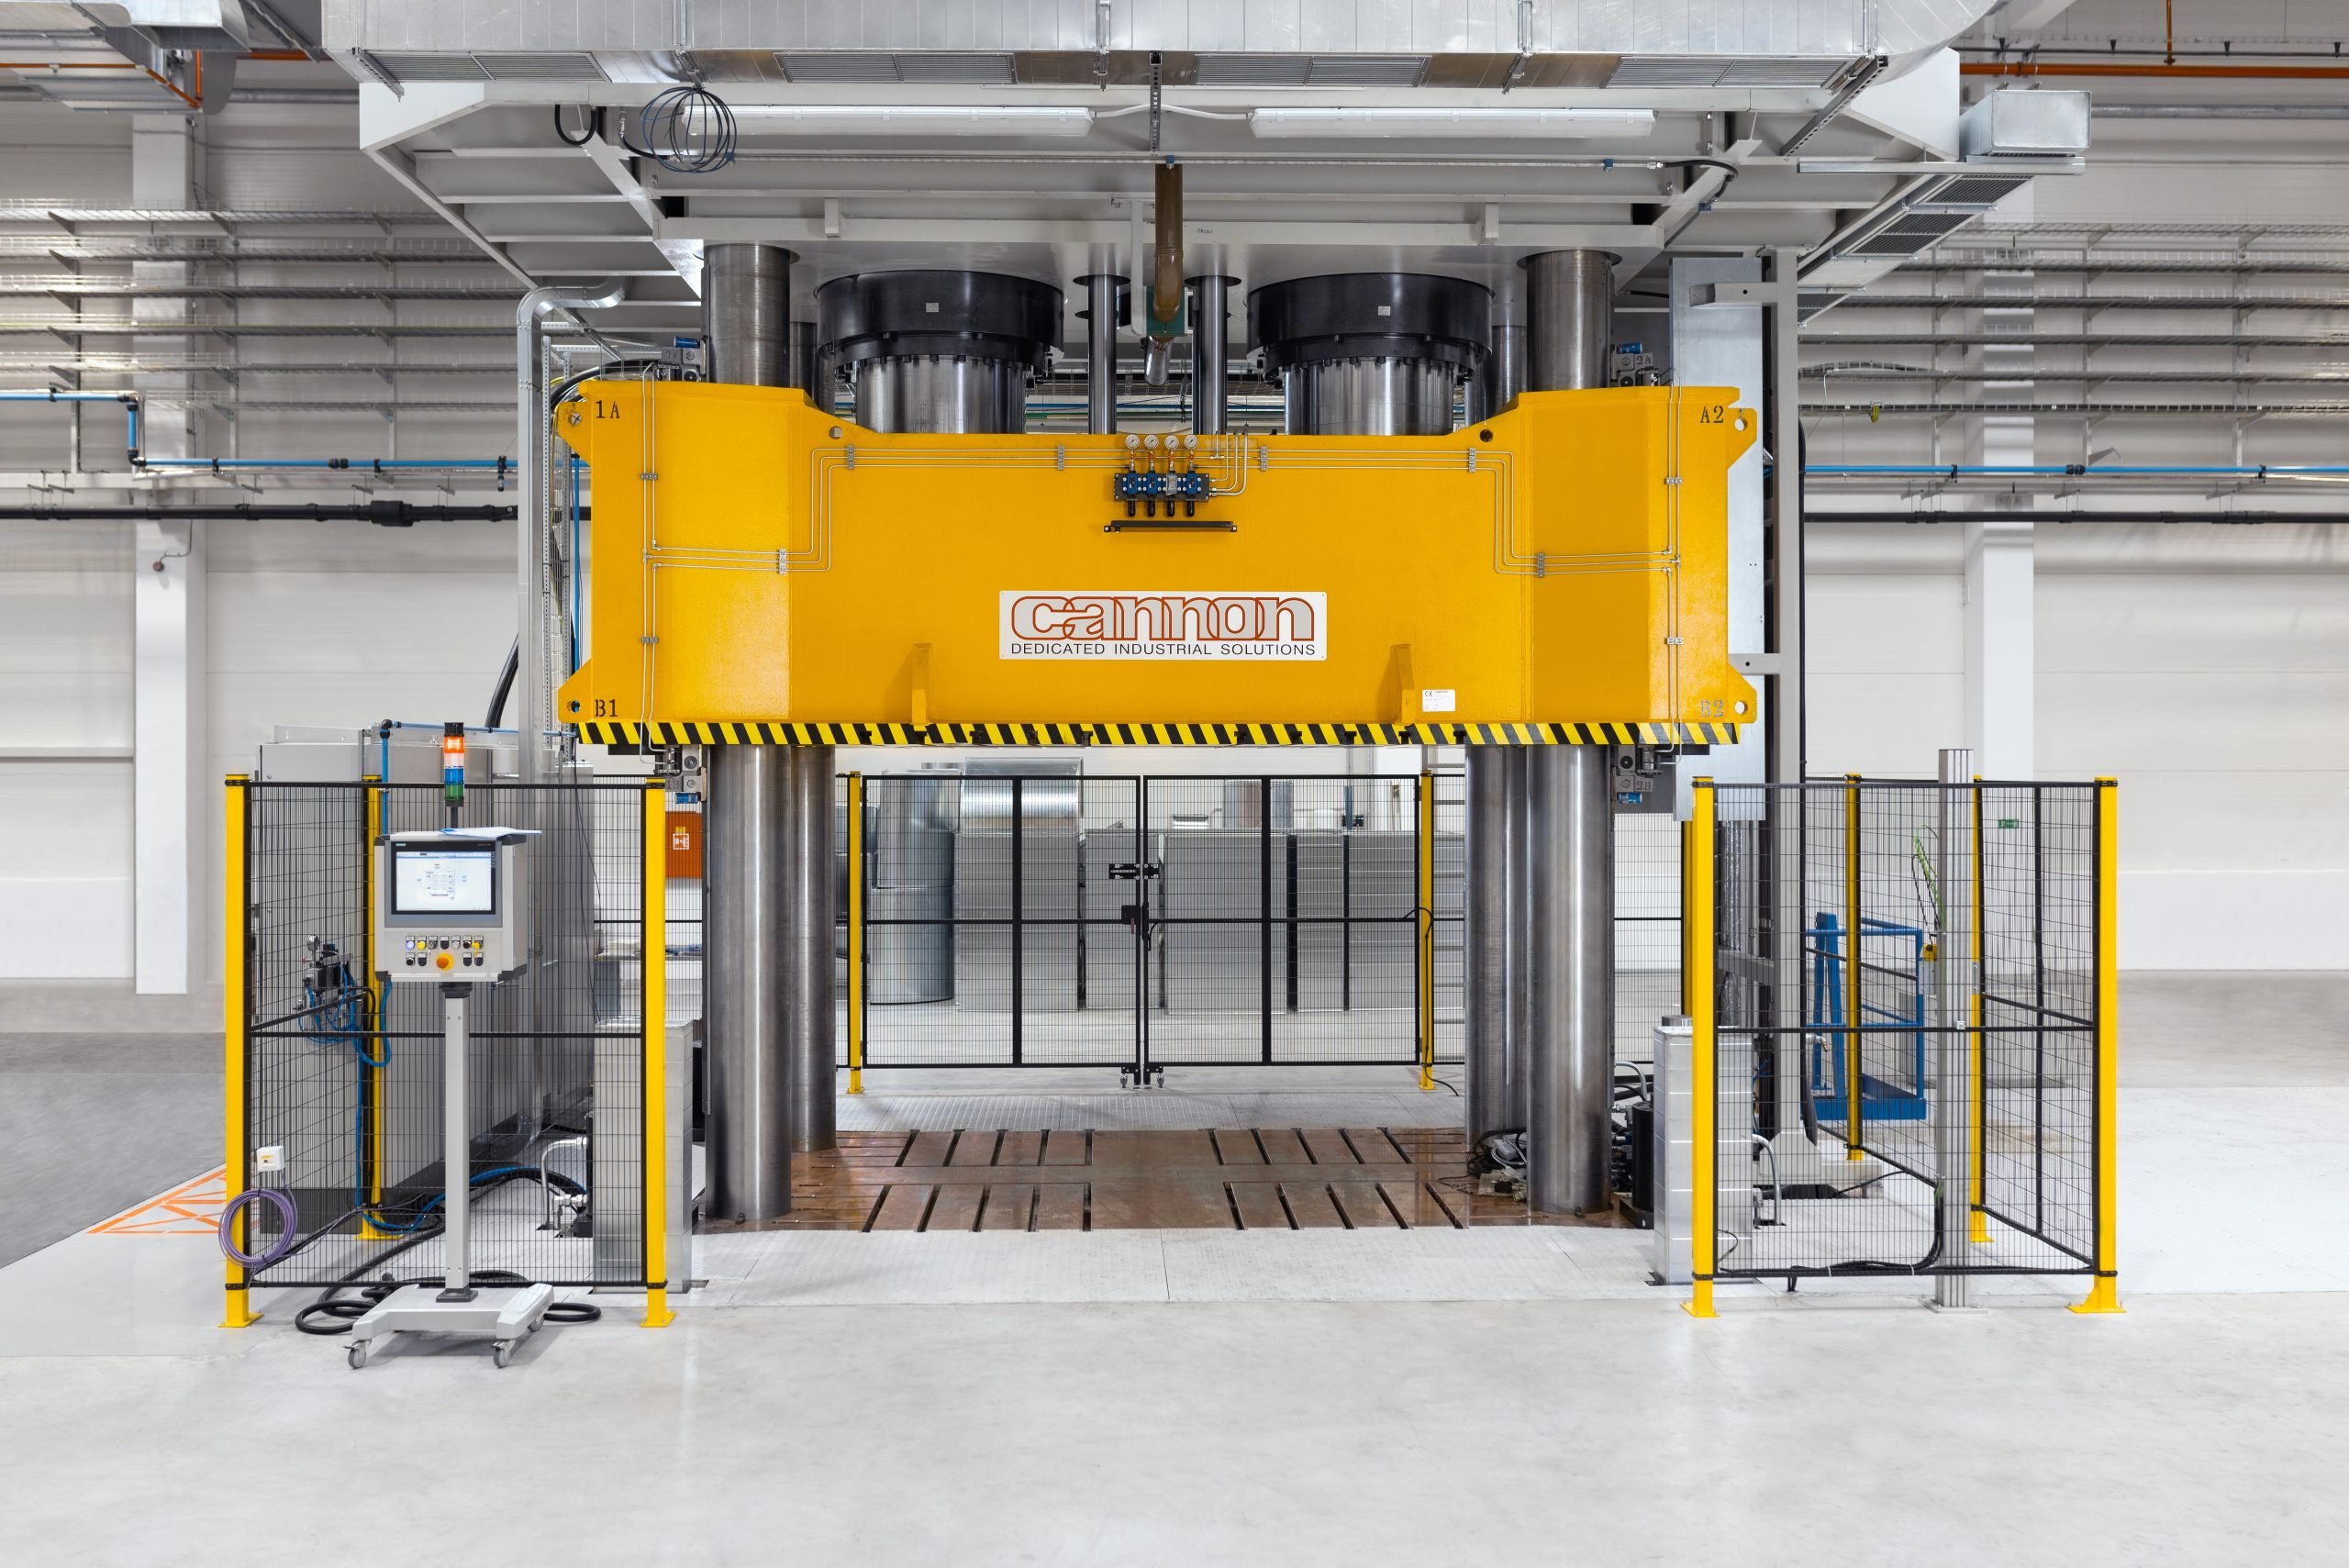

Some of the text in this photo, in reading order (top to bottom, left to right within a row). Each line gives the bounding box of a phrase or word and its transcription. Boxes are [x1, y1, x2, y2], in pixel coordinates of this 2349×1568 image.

[595, 399, 620, 419] 1A
[1699, 405, 1724, 424] A2
[1011, 596, 1315, 641] cannon
[1011, 643, 1316, 656] DEDICATED INDUSTRIAL SOLUTIONS
[595, 698, 618, 717] B1
[1700, 698, 1724, 717] B2
